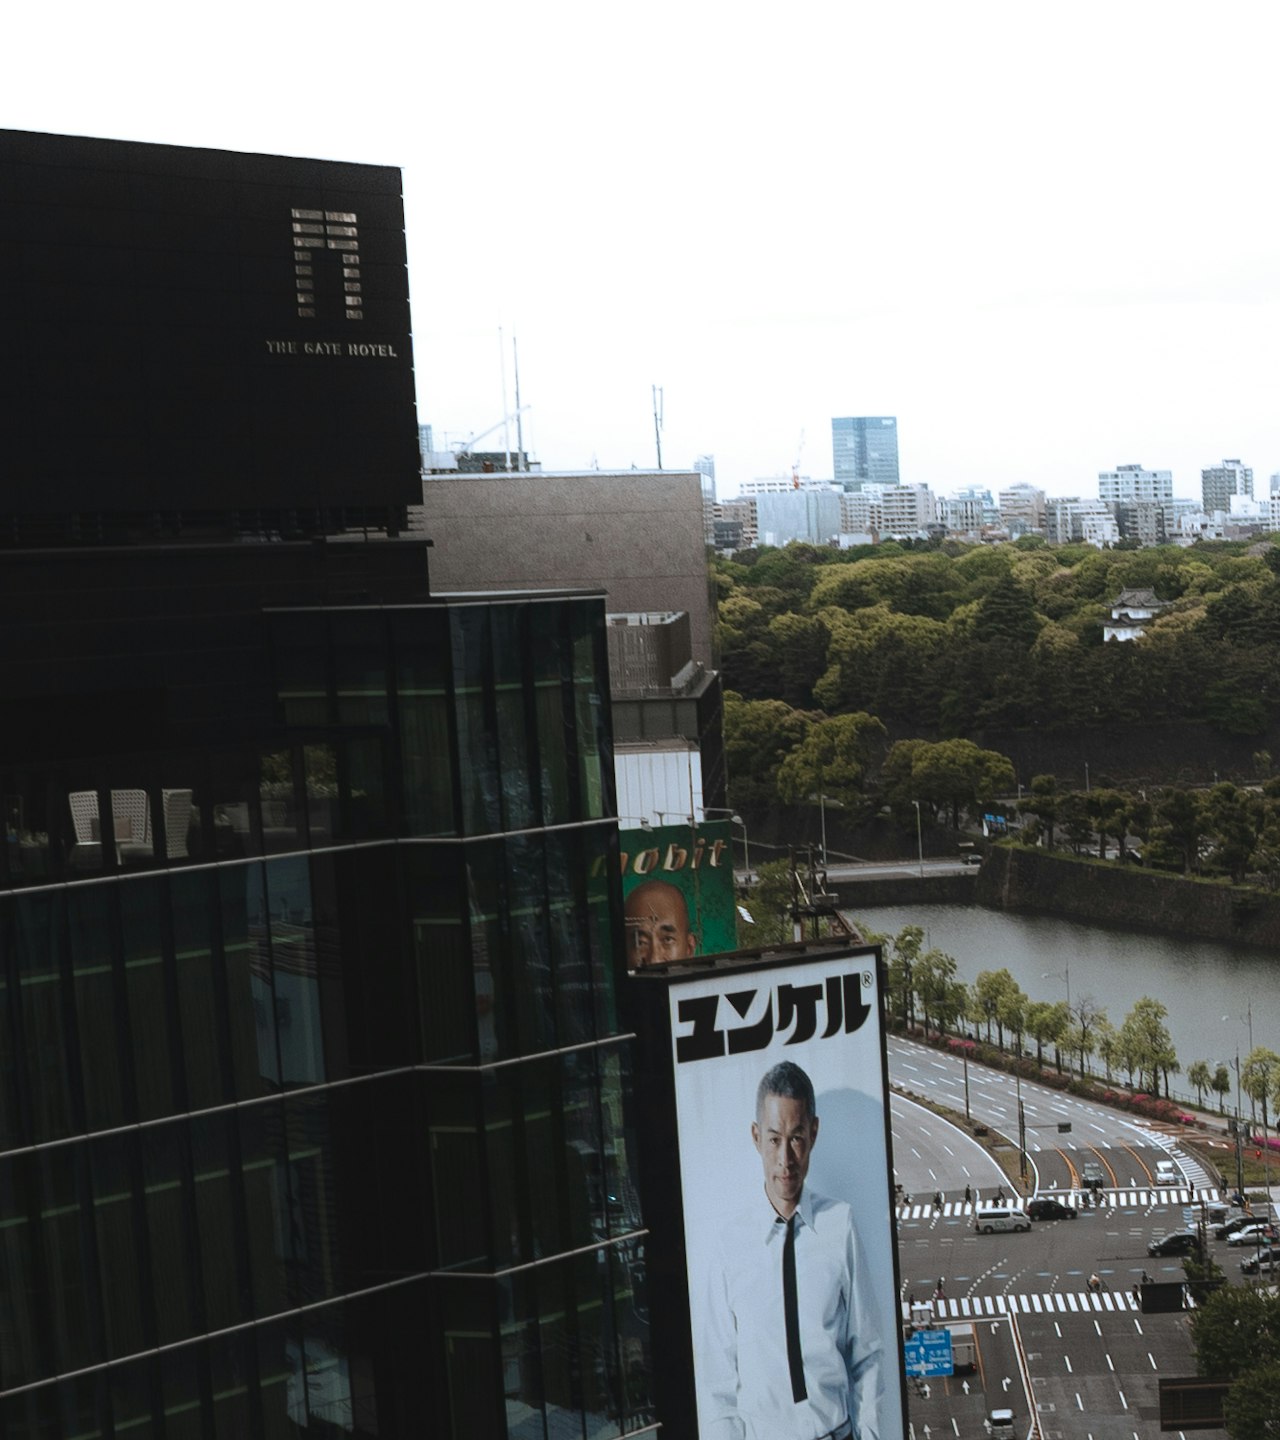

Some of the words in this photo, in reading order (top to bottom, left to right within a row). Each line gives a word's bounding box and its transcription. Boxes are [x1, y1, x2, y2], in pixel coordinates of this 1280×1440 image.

[265, 340, 297, 354] THE
[304, 342, 341, 356] GATE
[348, 343, 398, 358] HOTEL
